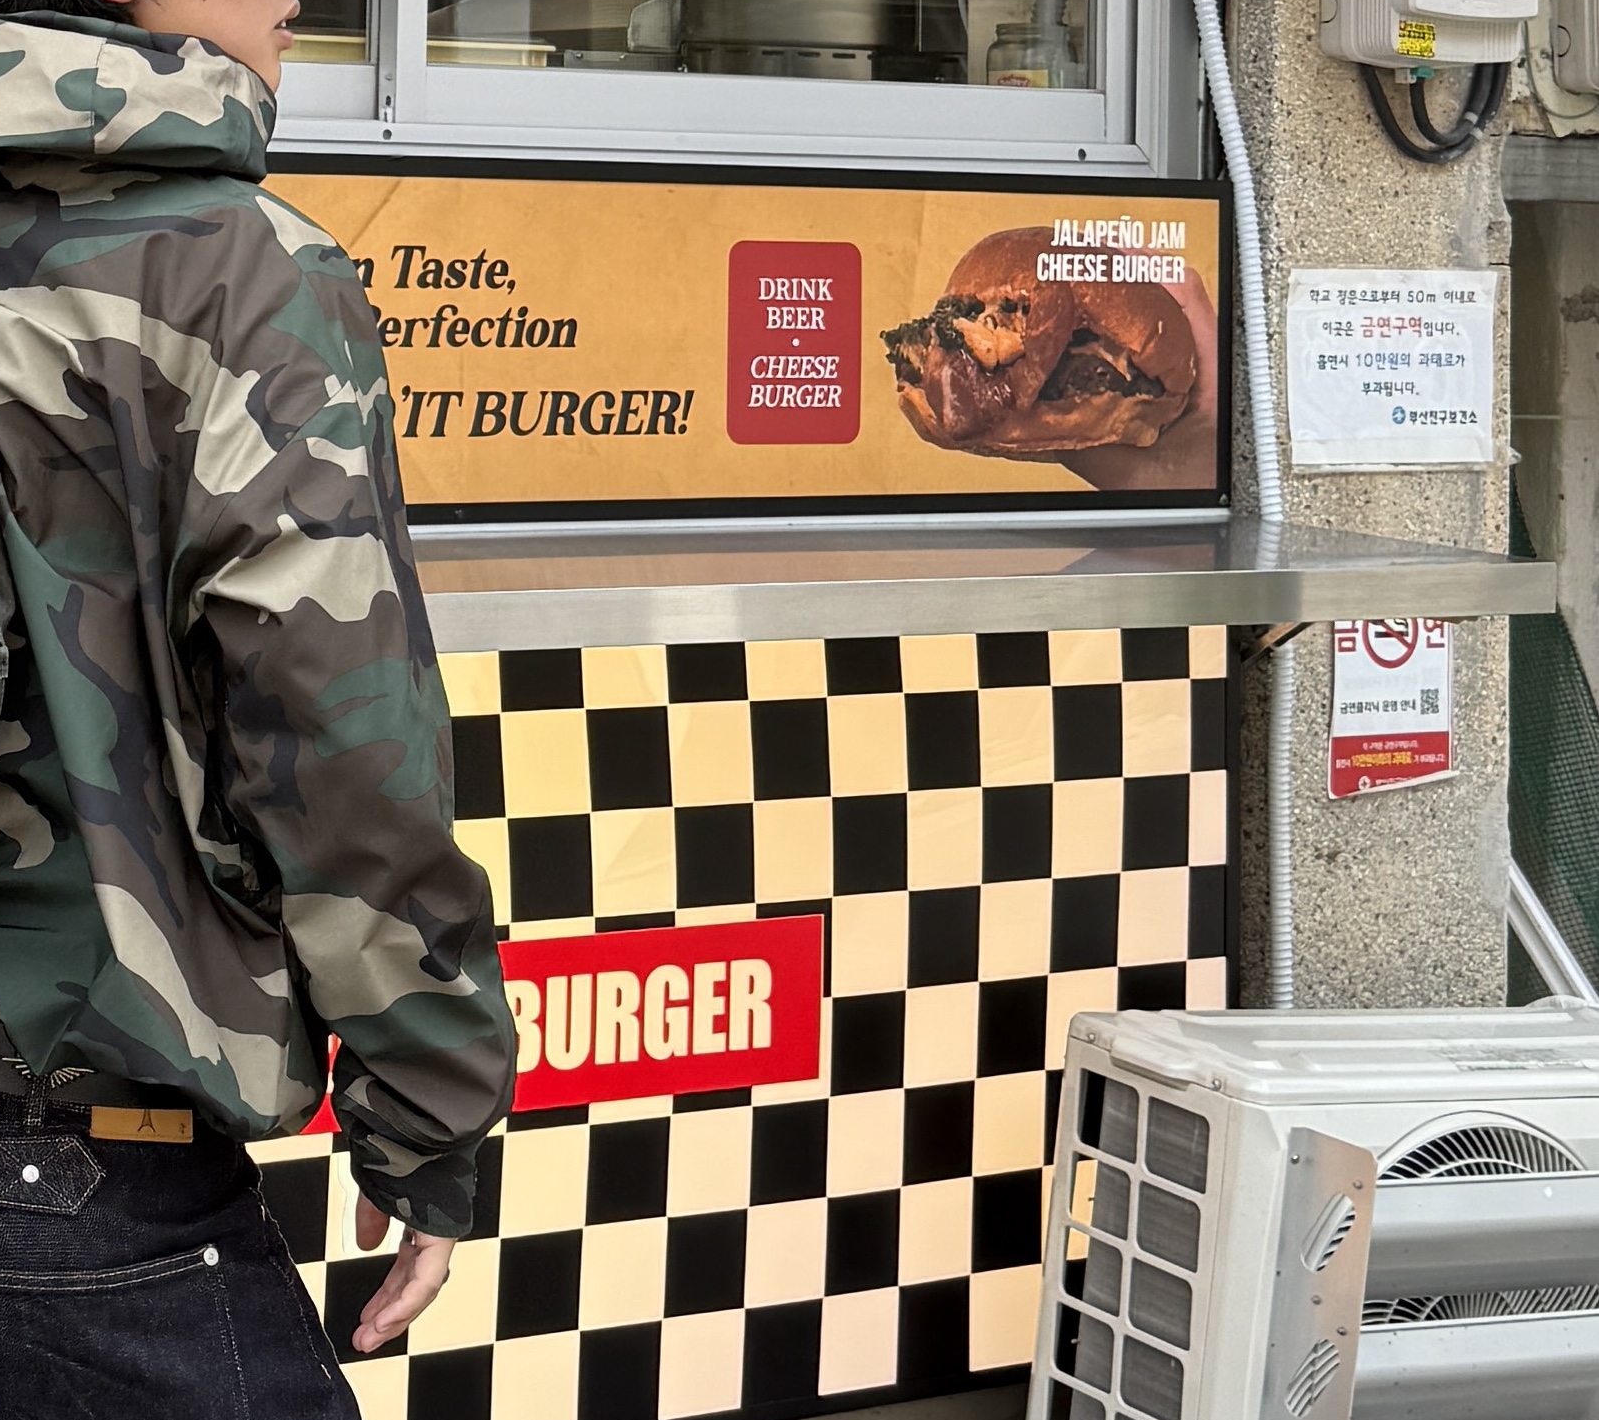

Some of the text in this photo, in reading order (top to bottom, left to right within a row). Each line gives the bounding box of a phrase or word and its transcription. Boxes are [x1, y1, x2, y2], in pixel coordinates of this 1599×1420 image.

[1050, 214, 1185, 249] JALAPEÑO JAM
[390, 244, 517, 296] Taste,
[1036, 252, 1186, 284] CHEESE BURGER
[758, 277, 834, 301] DRINK
[1407, 290, 1437, 304] 50m
[370, 303, 579, 348] erfection
[766, 306, 826, 330] BEER
[750, 355, 840, 379] CHEESE
[1356, 352, 1411, 371] 10만원의
[747, 384, 843, 408] BURGER
[467, 389, 695, 437] BURGER!
[504, 958, 772, 1074] BURGER
